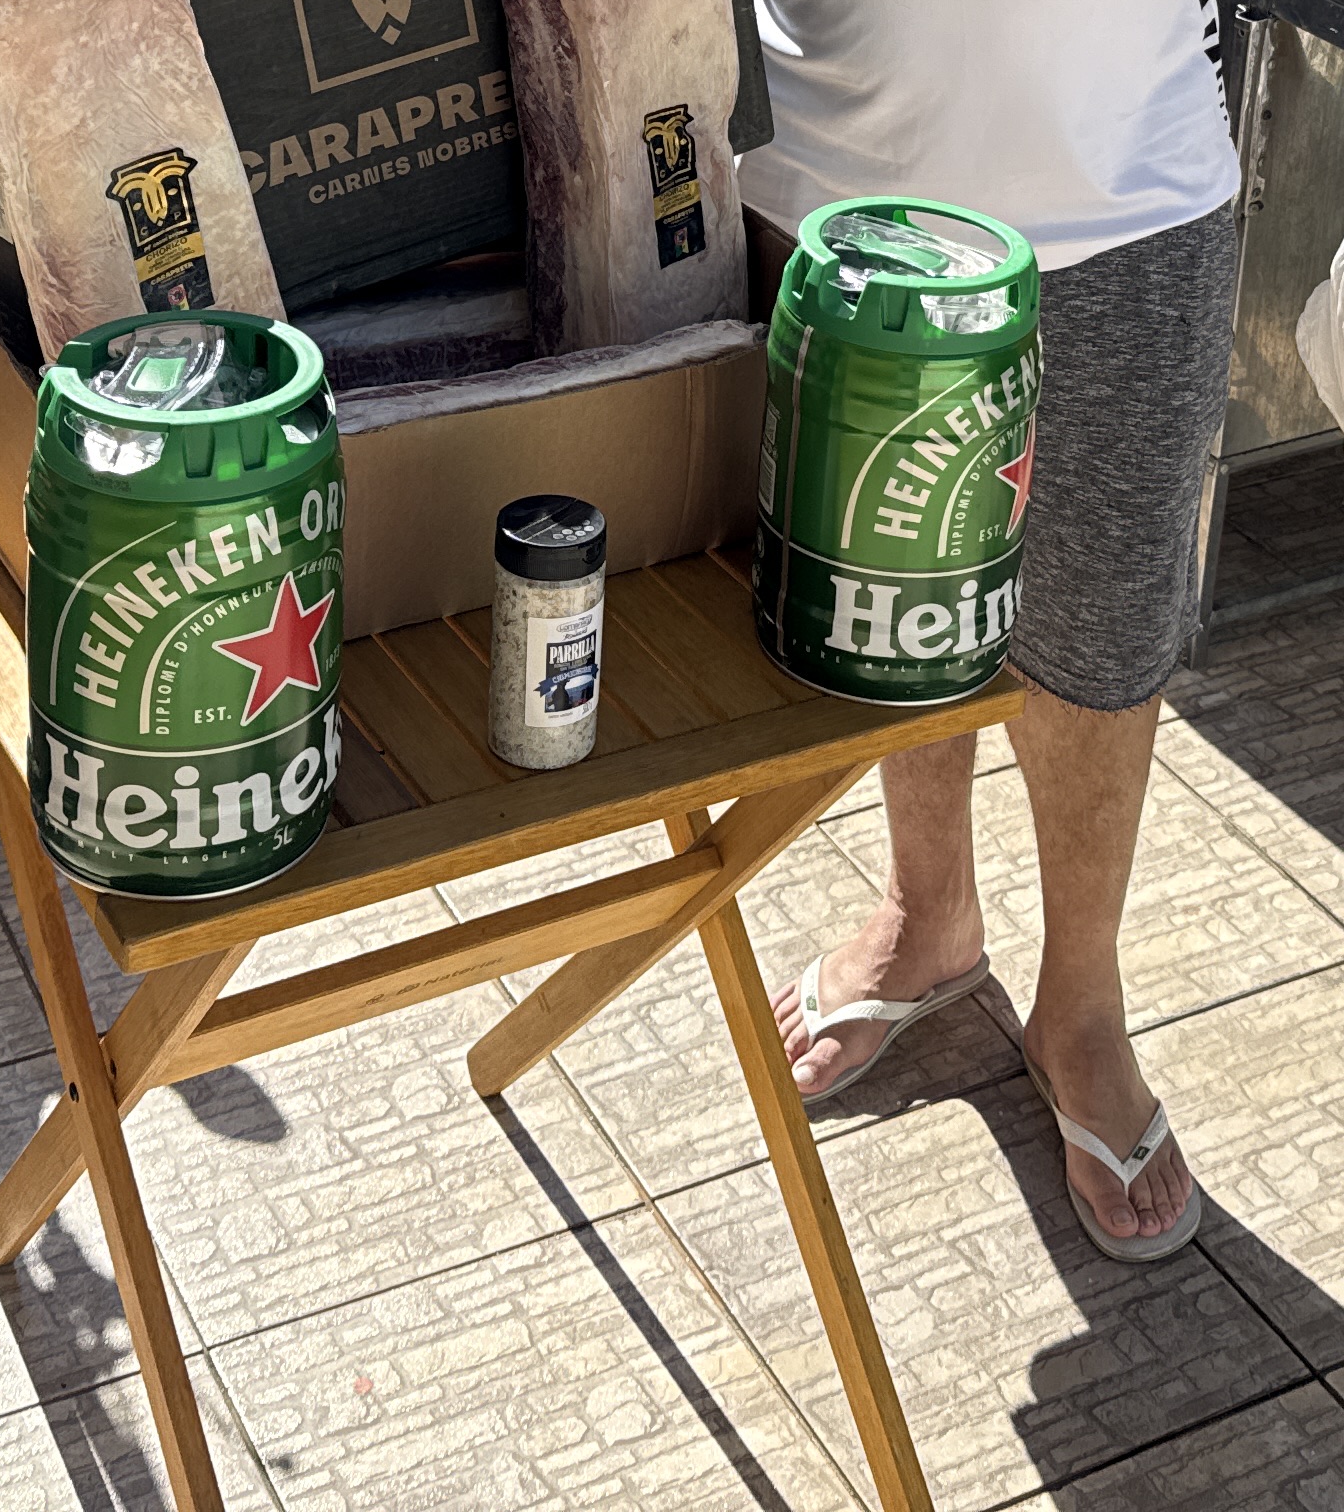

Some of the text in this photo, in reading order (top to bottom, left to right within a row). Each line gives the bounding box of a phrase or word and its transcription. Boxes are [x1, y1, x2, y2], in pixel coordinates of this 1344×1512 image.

[308, 121, 518, 204] CARNES NOBRES
[145, 236, 188, 263] CHORIZO
[873, 347, 1037, 540] HEINEKEN
[950, 488, 974, 556] DIPLOME
[977, 523, 1003, 543] EST.
[74, 507, 283, 709] HEINEKEN
[824, 572, 1023, 661] Hein
[155, 580, 274, 735] DIPLOME D'HONNEUR
[193, 705, 232, 724] EST.
[77, 827, 294, 865] MALT LAGER 5L
